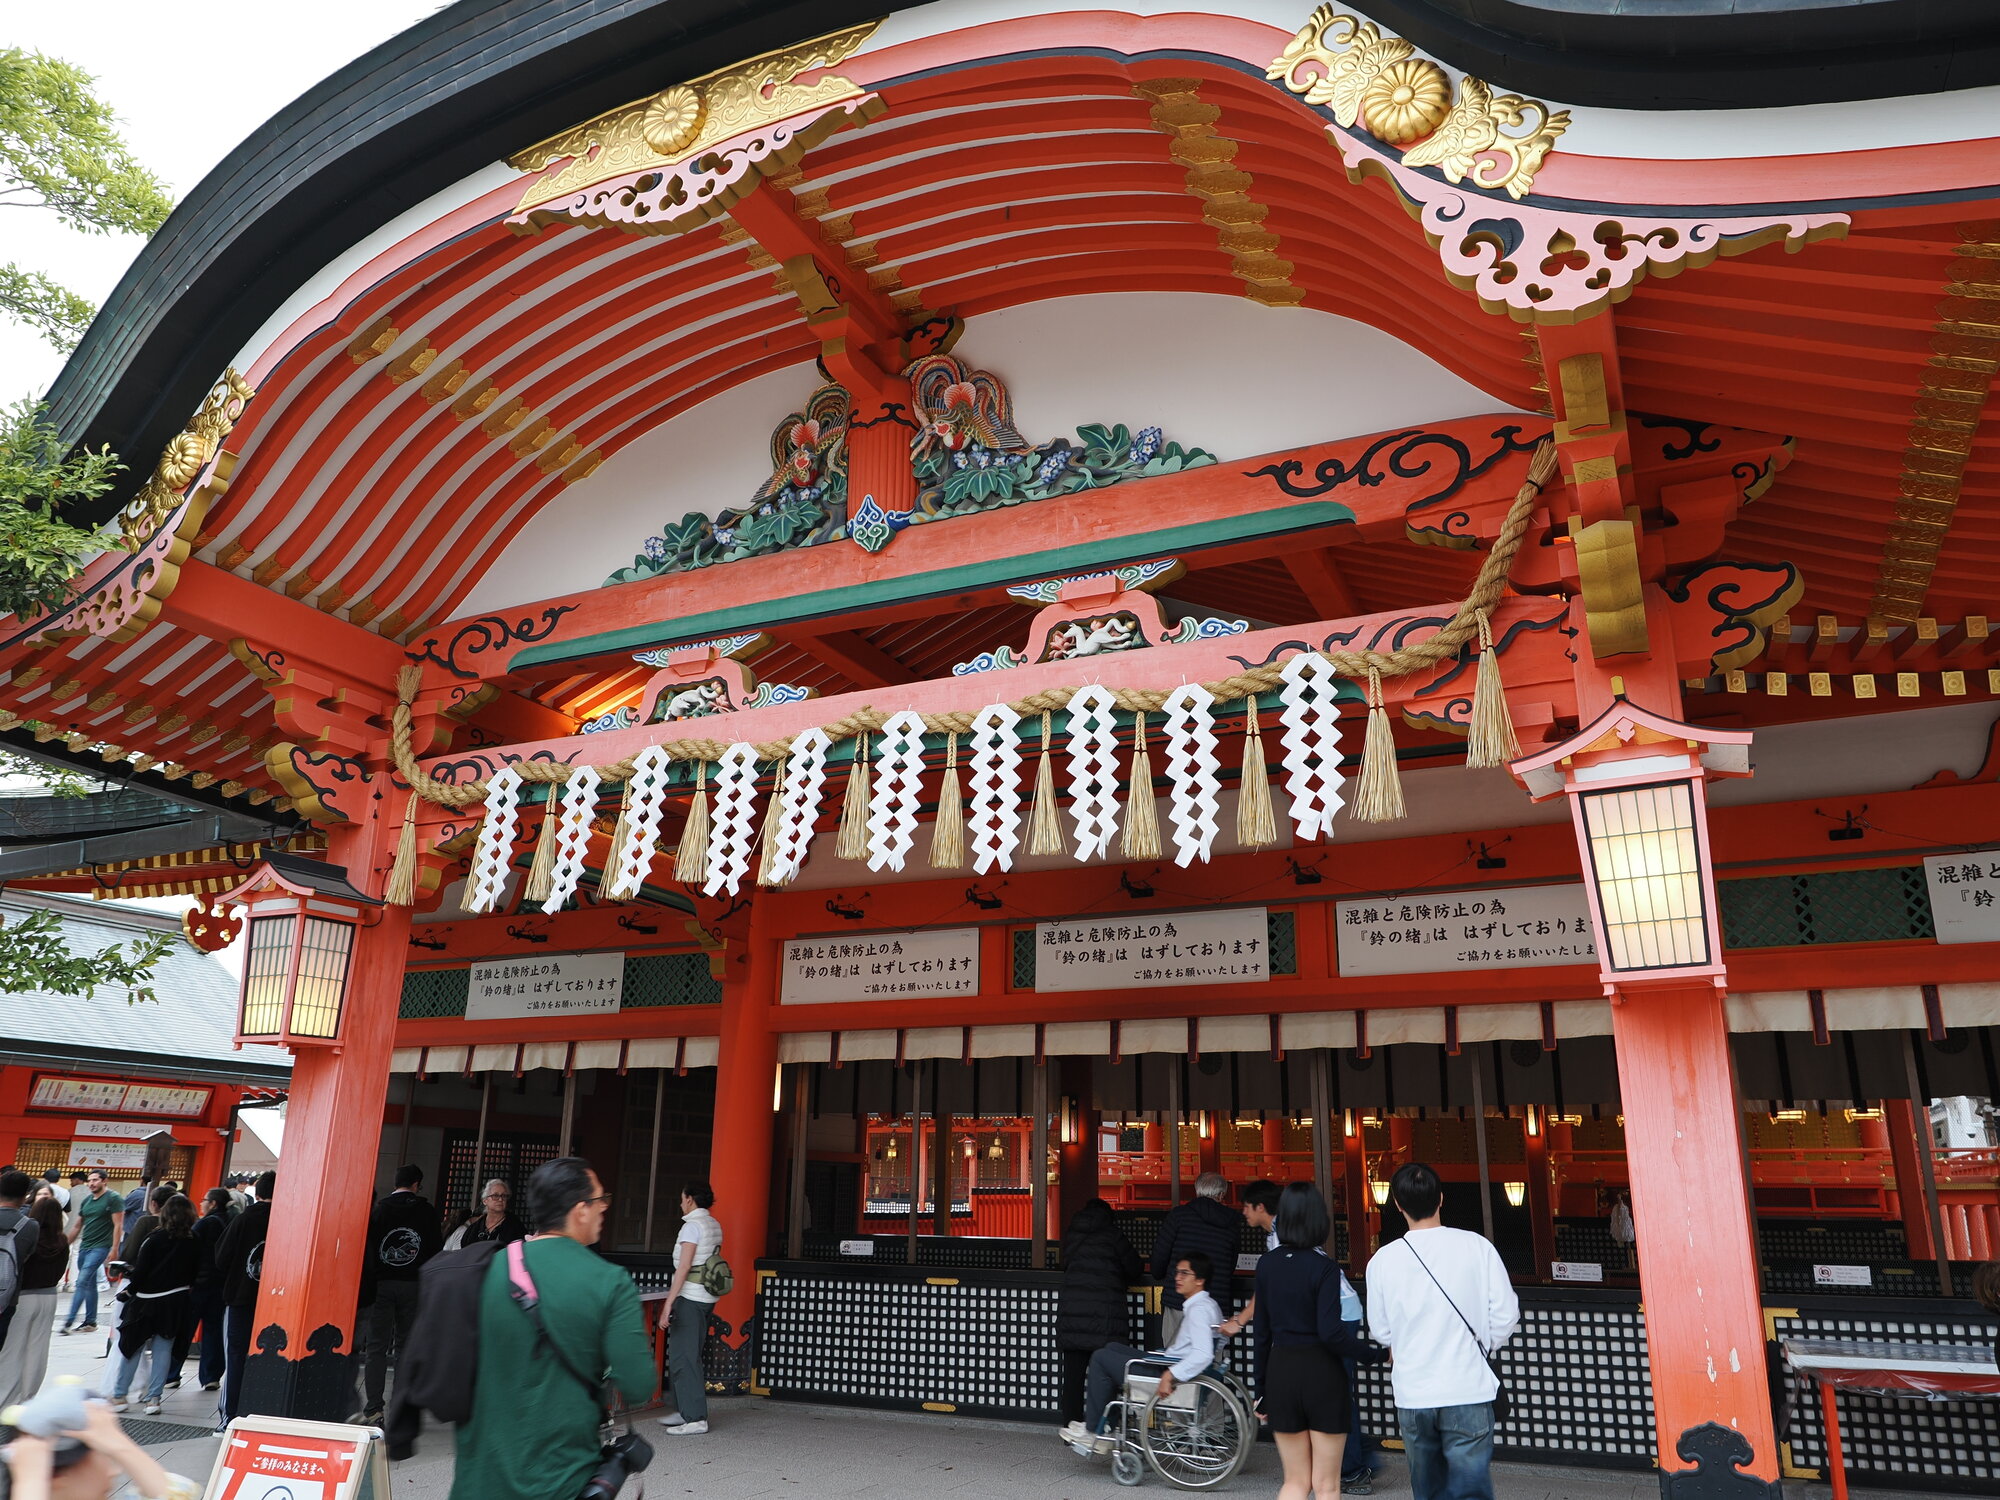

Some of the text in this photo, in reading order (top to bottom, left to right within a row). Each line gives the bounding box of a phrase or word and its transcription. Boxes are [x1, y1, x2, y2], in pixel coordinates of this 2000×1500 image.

[1937, 863, 2000, 884] 混雑と
[1961, 889, 1996, 907] 『鈴
[1345, 898, 1506, 925] 混雑と危険防止の為
[1043, 922, 1177, 945] 混雑と危険防止の為
[1360, 917, 1593, 946] 『鈴の緒』は はずしておりま
[789, 941, 903, 961] 混雑と危険防止の為
[1055, 938, 1261, 965] 『鈴の緒』は はずしております
[474, 963, 561, 981] 混雑と危険防止の為
[871, 957, 972, 975] はずしております
[1133, 963, 1261, 980] ご協力をお願いいたします
[533, 977, 617, 994] はずしております
[863, 979, 972, 994] ご協力をお願いいたします
[89, 1124, 132, 1135] おみくじ
[252, 1456, 325, 1475] ご参拝のみなさまへ
